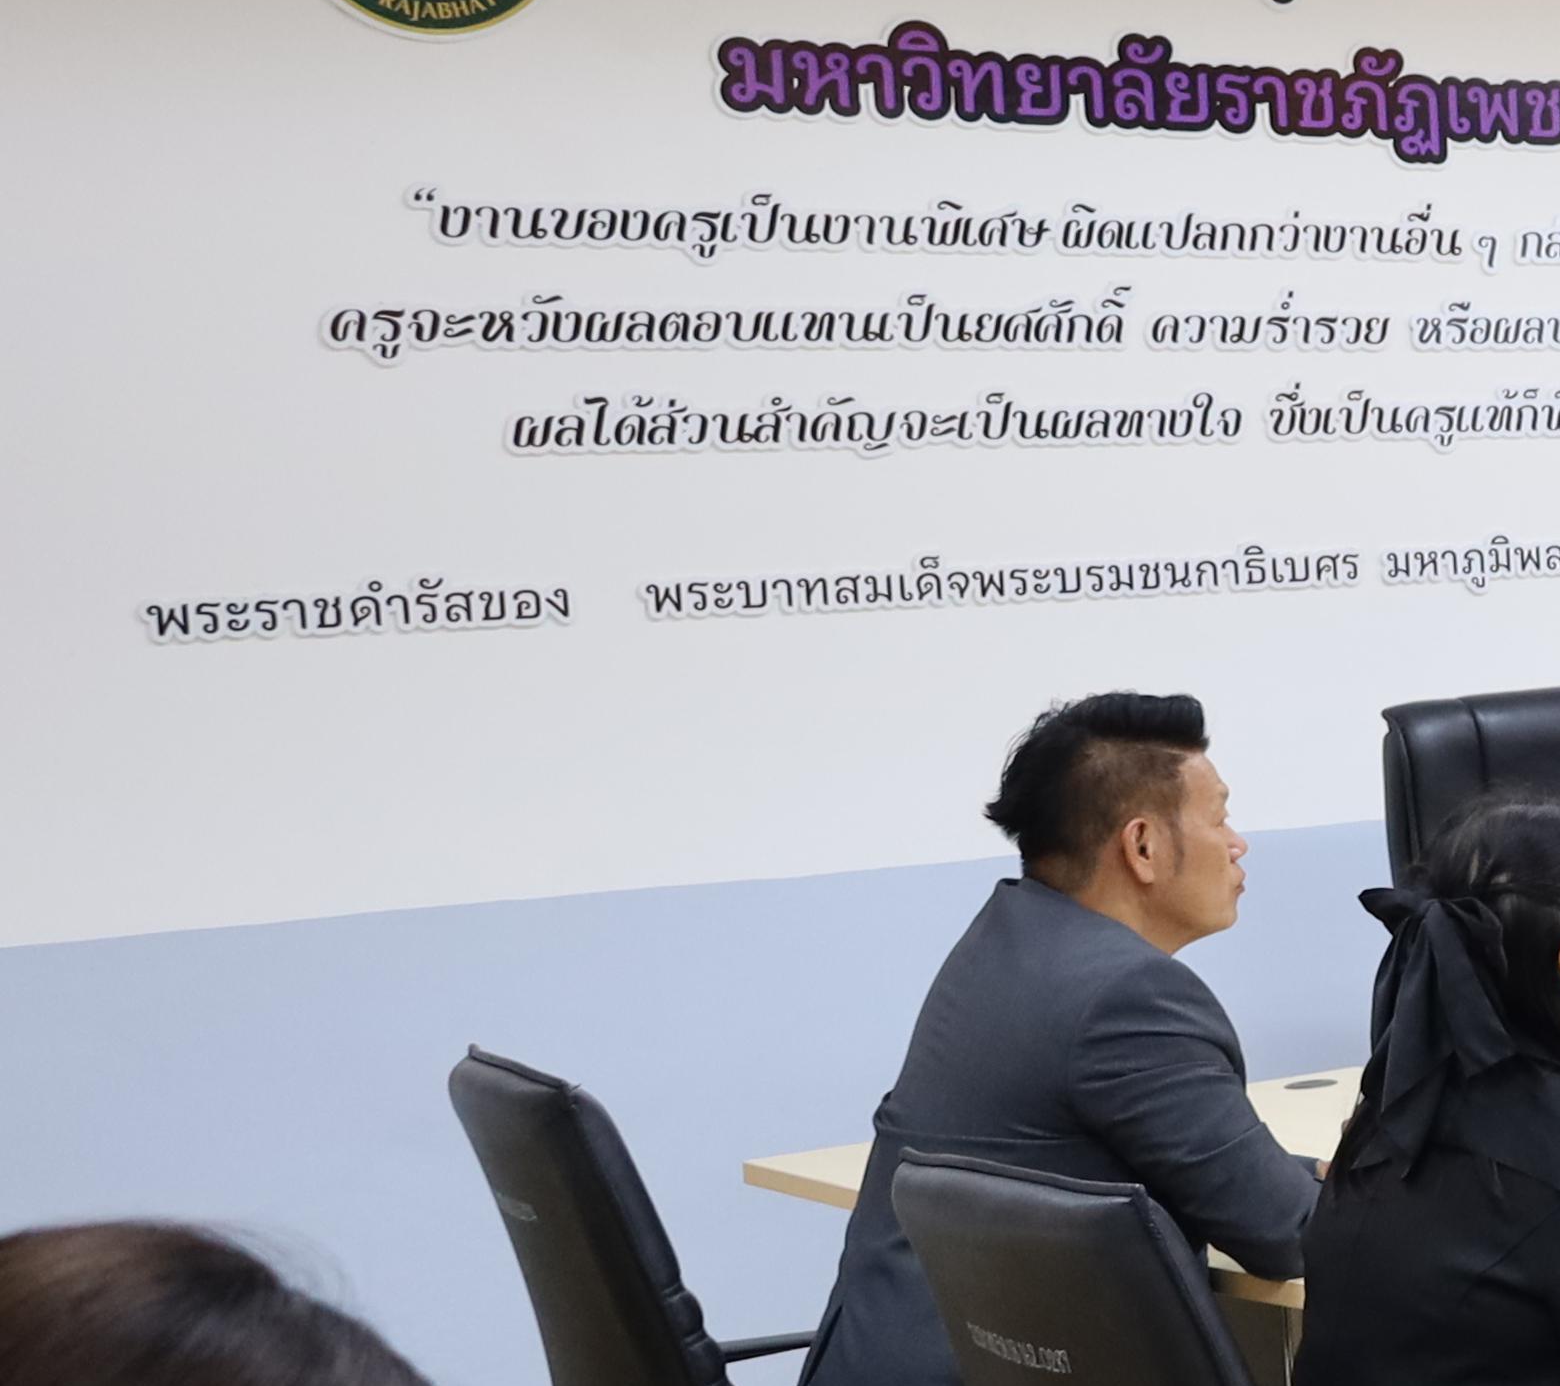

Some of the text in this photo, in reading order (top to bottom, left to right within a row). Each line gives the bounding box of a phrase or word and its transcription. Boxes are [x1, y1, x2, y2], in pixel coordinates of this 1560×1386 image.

[1062, 203, 1462, 256] ผิดแปลกกว่างานอื่น
[1477, 235, 1498, 267] ๆ
[330, 286, 1131, 360] ครูจะหวังผลตอบแทนเป็นยศศักดิ์
[1151, 291, 1390, 344] ความร่ำรวย
[512, 391, 1242, 452] ผลได้ส่วนสำคัญจะเป็นผลทางใจ
[146, 577, 570, 637] พระราชดำรัสของ
[645, 545, 1359, 614] พระบาทสมเด็จพระบรมชนกาธิเบศร
